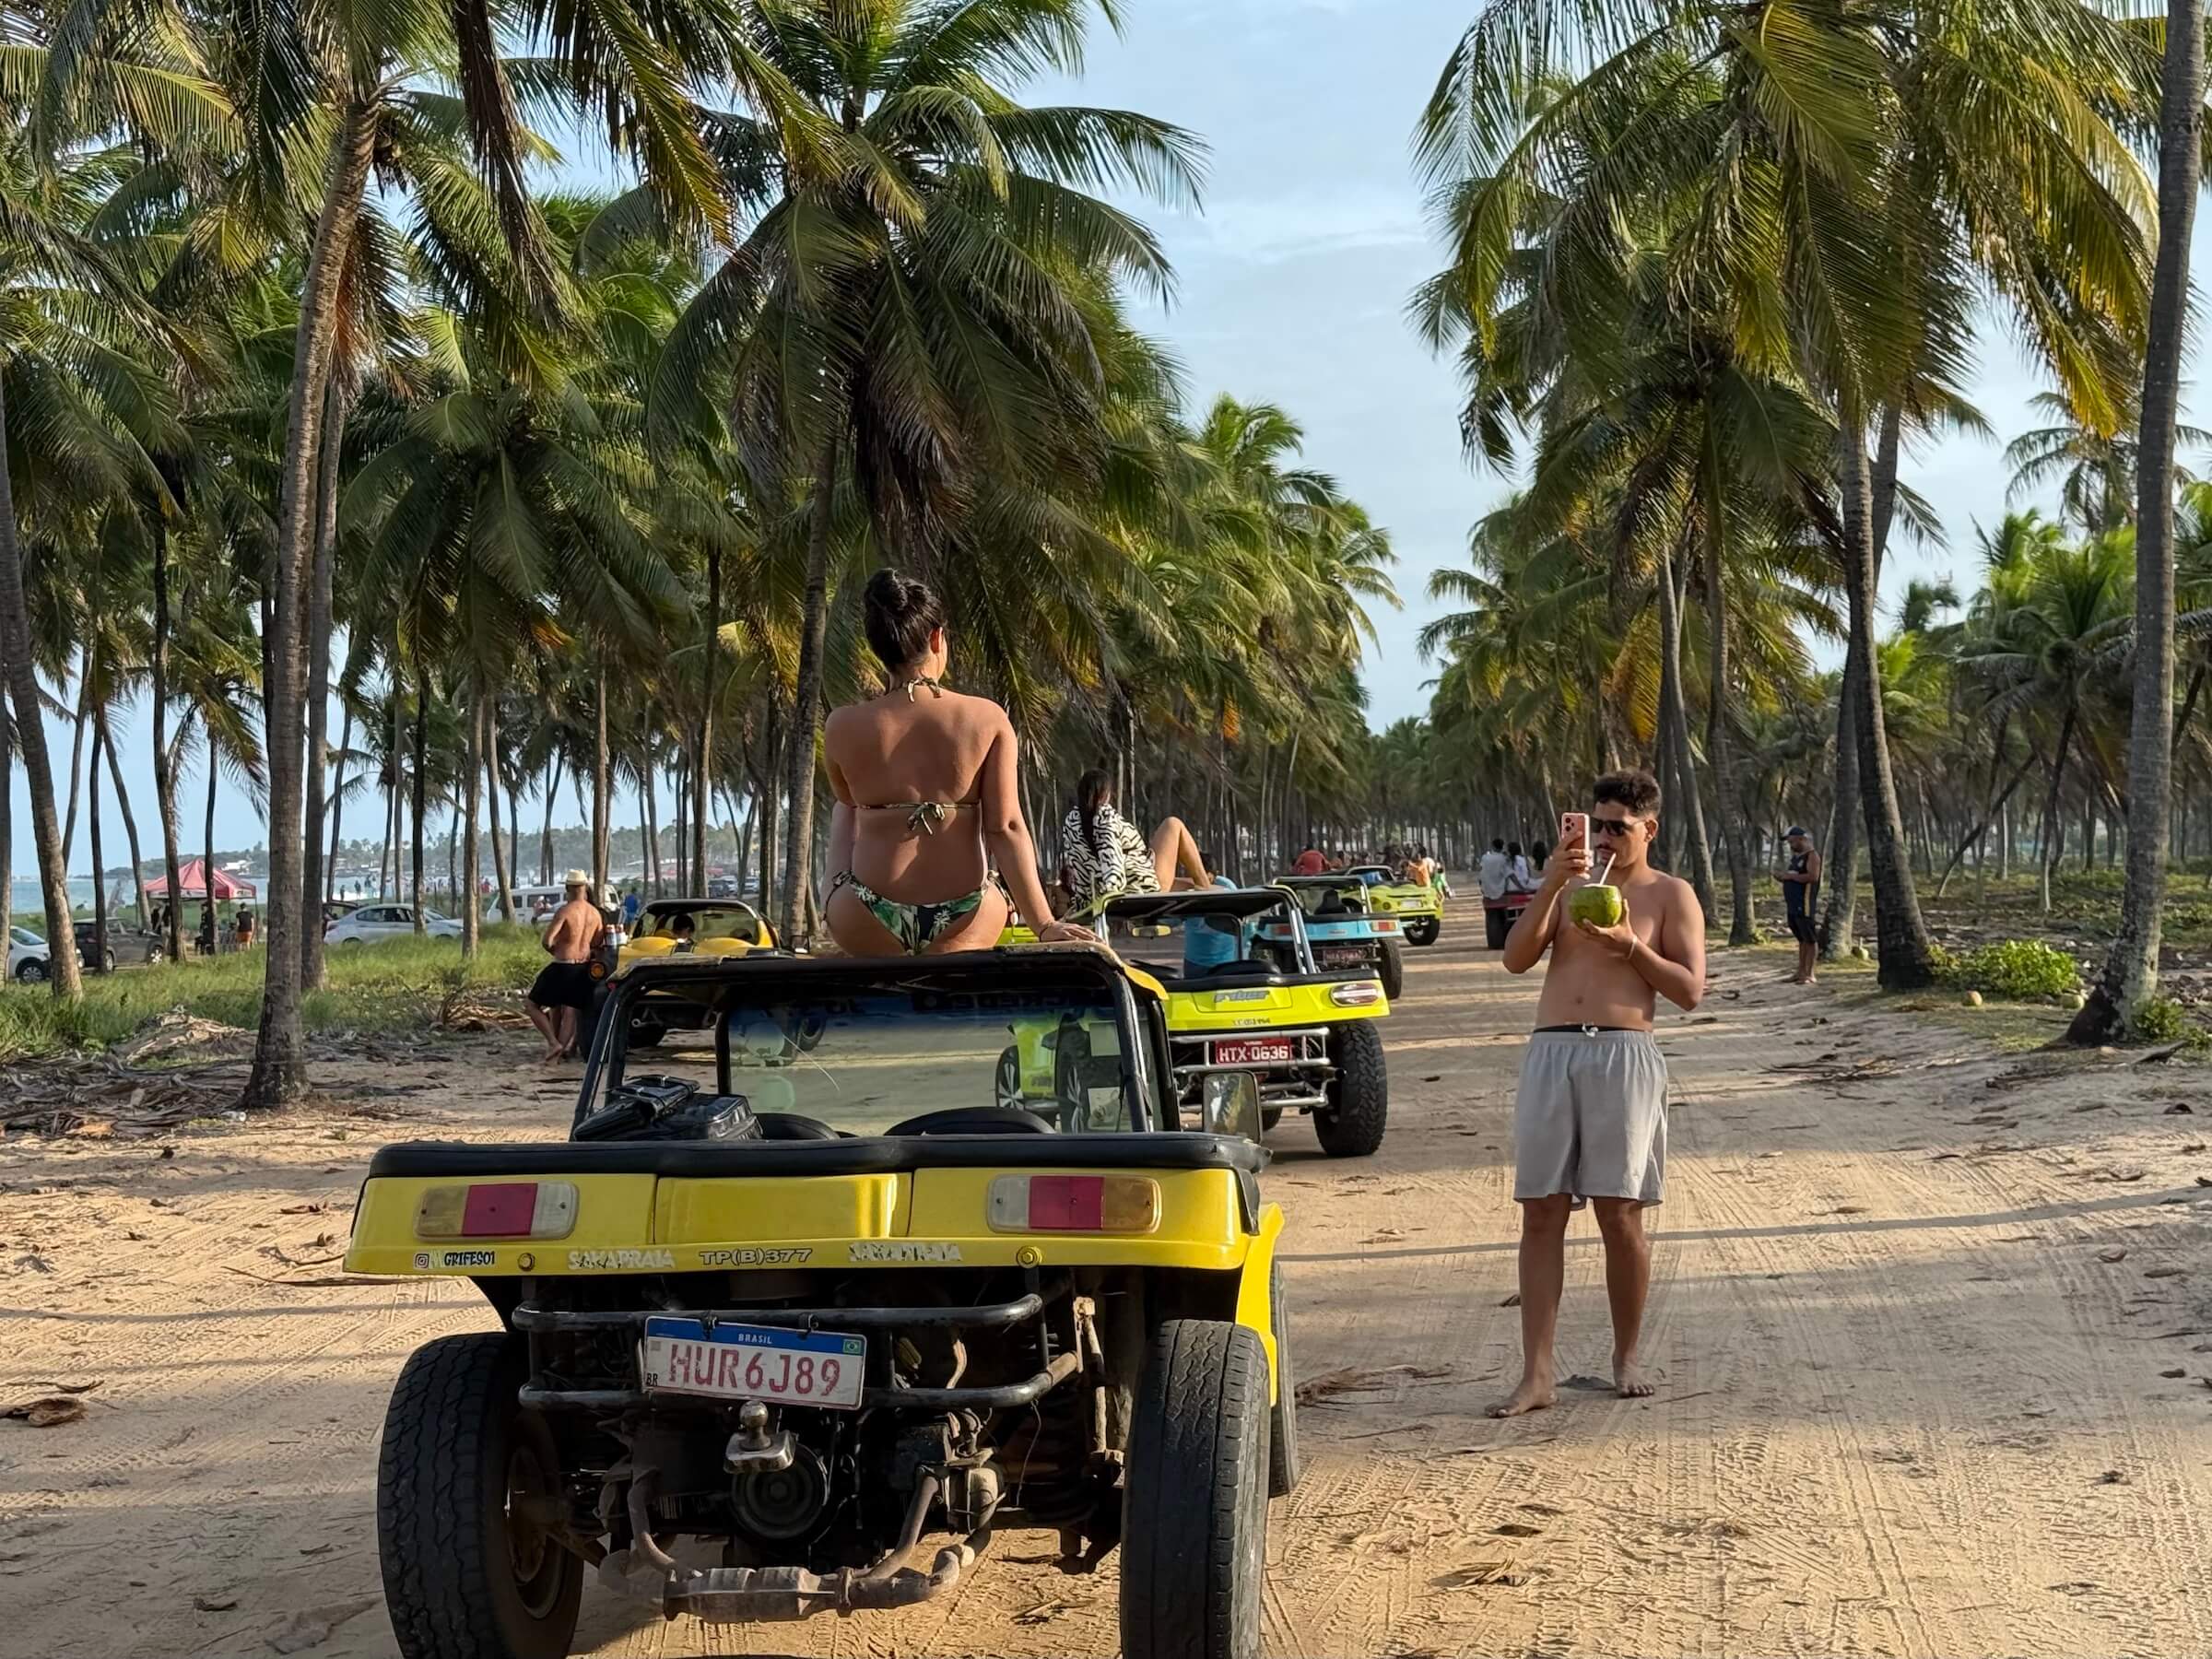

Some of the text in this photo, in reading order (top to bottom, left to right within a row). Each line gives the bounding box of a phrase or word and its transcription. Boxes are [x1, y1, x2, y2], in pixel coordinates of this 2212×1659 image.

[699, 1248, 813, 1266] TP(B)377
[738, 1334, 772, 1345] BRASIL
[668, 1343, 841, 1397] HUR6J89
[646, 1372, 658, 1386] BR
